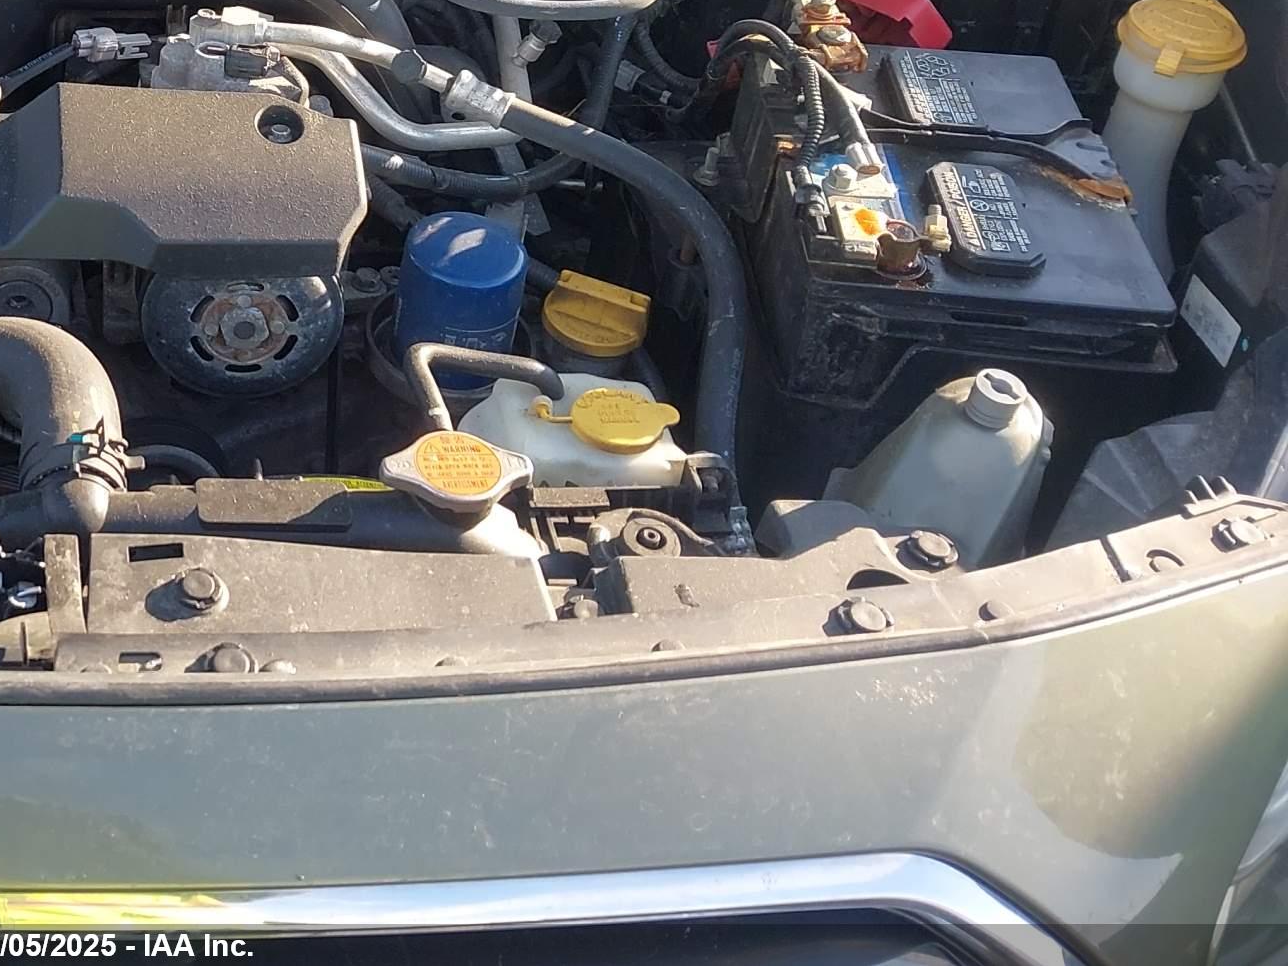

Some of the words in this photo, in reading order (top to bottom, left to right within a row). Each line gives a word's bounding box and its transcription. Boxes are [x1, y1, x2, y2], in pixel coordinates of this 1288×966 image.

[942, 170, 963, 200] POISON
[956, 206, 978, 238] DANGER
[441, 443, 481, 454] WARNING
